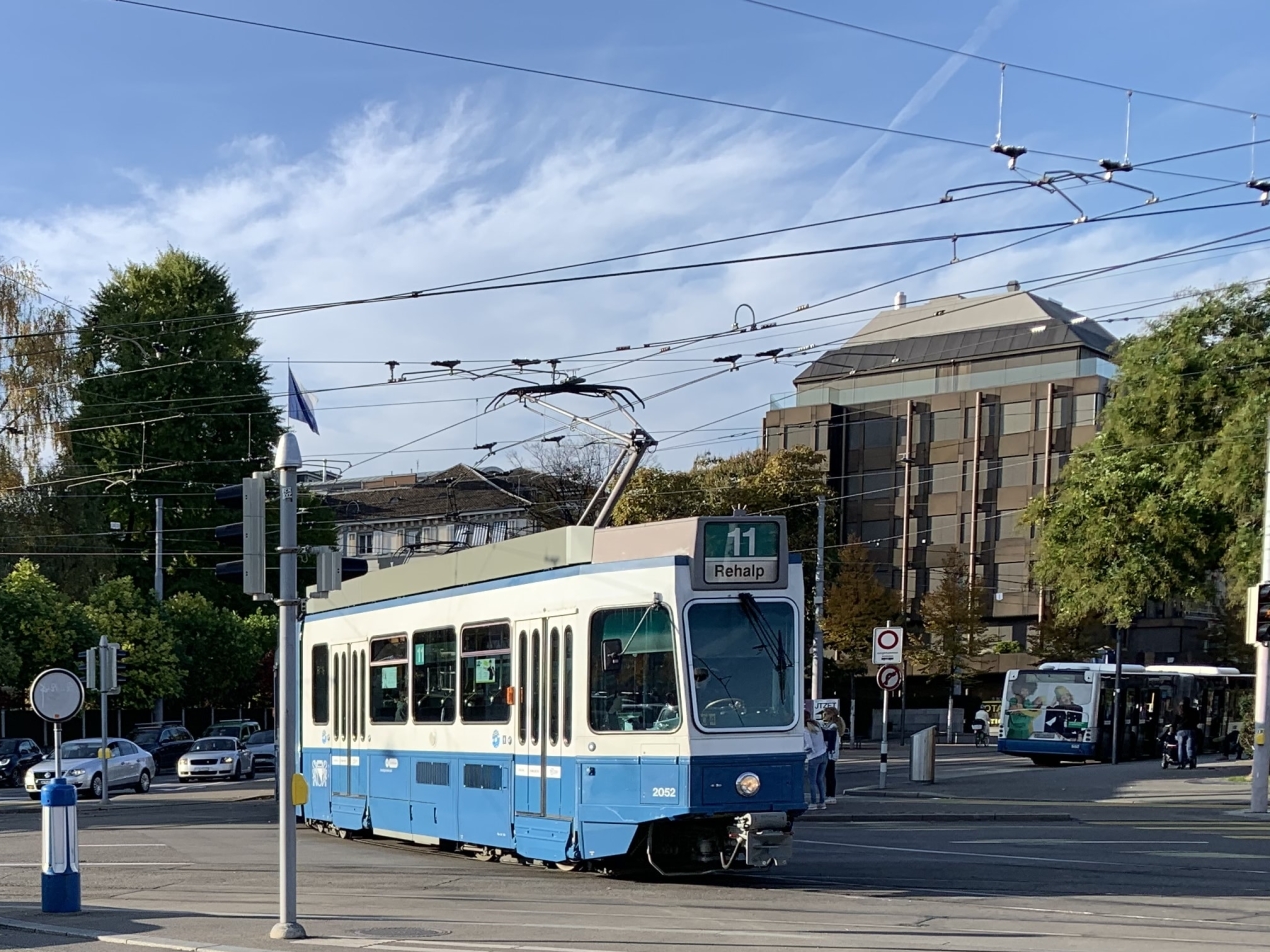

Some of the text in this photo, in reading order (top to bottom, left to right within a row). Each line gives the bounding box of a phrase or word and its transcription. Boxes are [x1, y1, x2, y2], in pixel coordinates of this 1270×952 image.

[727, 527, 756, 556] 11
[714, 564, 765, 580] Rehalp
[417, 647, 425, 663] 11
[652, 787, 676, 798] 2052
